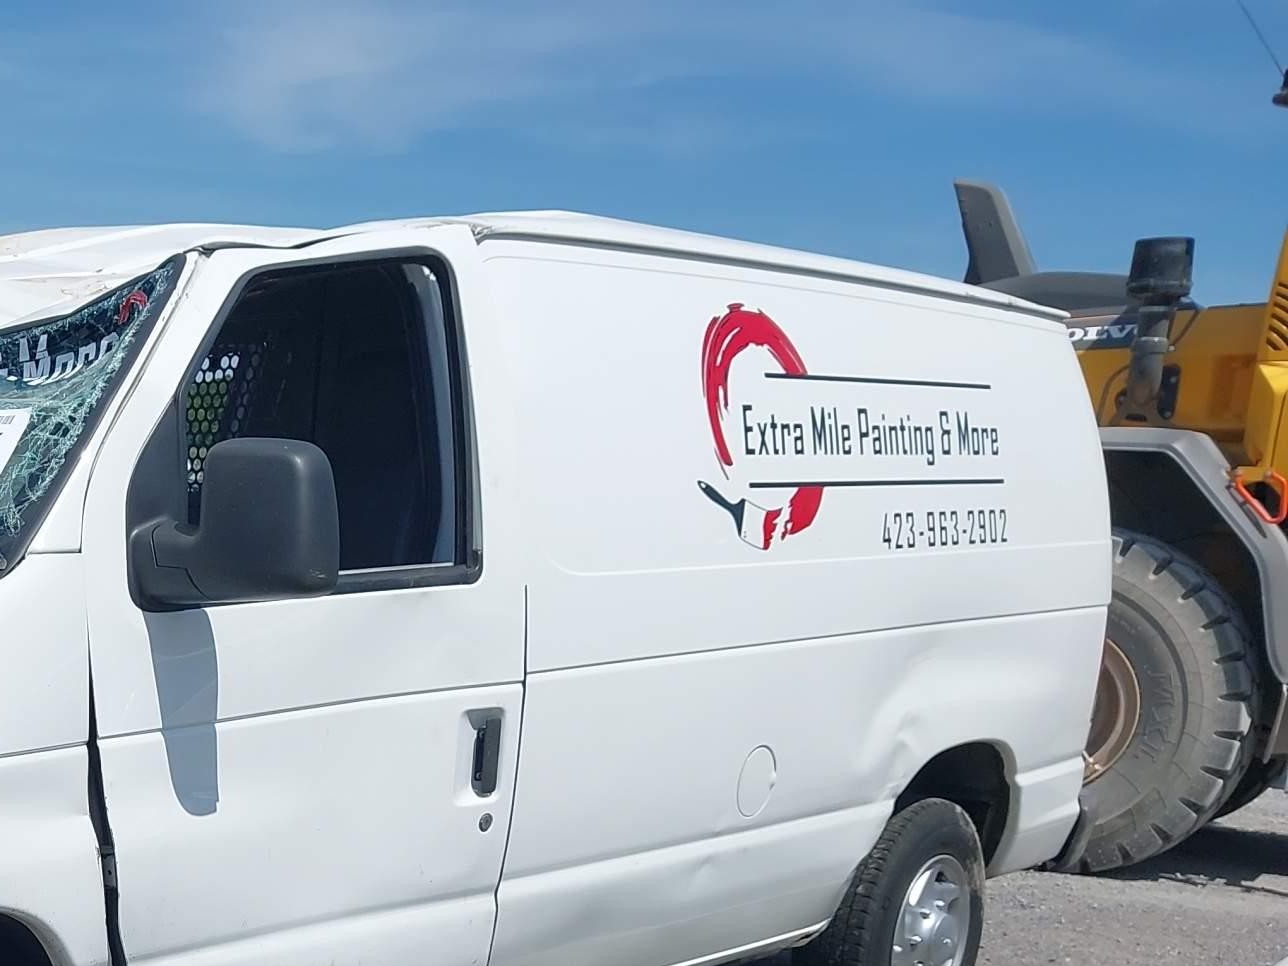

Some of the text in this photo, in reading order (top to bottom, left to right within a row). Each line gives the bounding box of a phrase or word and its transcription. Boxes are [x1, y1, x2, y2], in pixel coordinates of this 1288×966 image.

[1067, 324, 1137, 342] OLV
[742, 404, 1000, 466] Extra Mile Painting & More
[882, 509, 1008, 550] 423-963-2902
